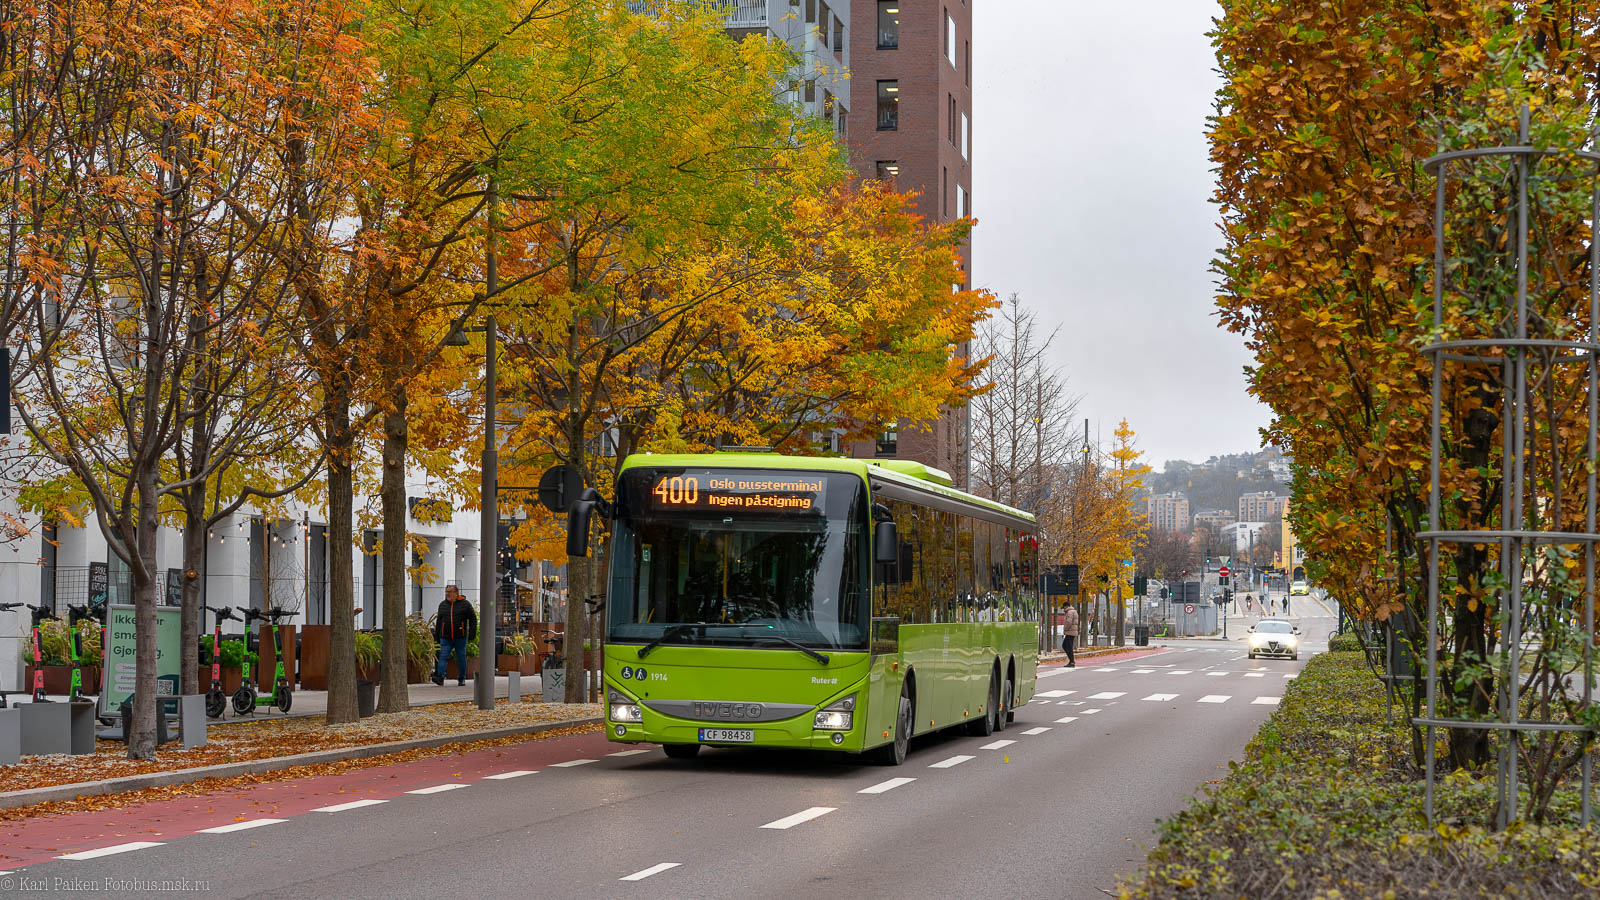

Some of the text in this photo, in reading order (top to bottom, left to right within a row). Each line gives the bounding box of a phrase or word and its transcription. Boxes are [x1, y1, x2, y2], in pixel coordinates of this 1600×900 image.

[653, 476, 698, 504] 400
[709, 478, 735, 490] Oslo
[708, 494, 811, 509] Ingen påstigning
[650, 672, 668, 682] 1914
[694, 702, 762, 719] IVECO
[706, 730, 751, 741] CF 98458
